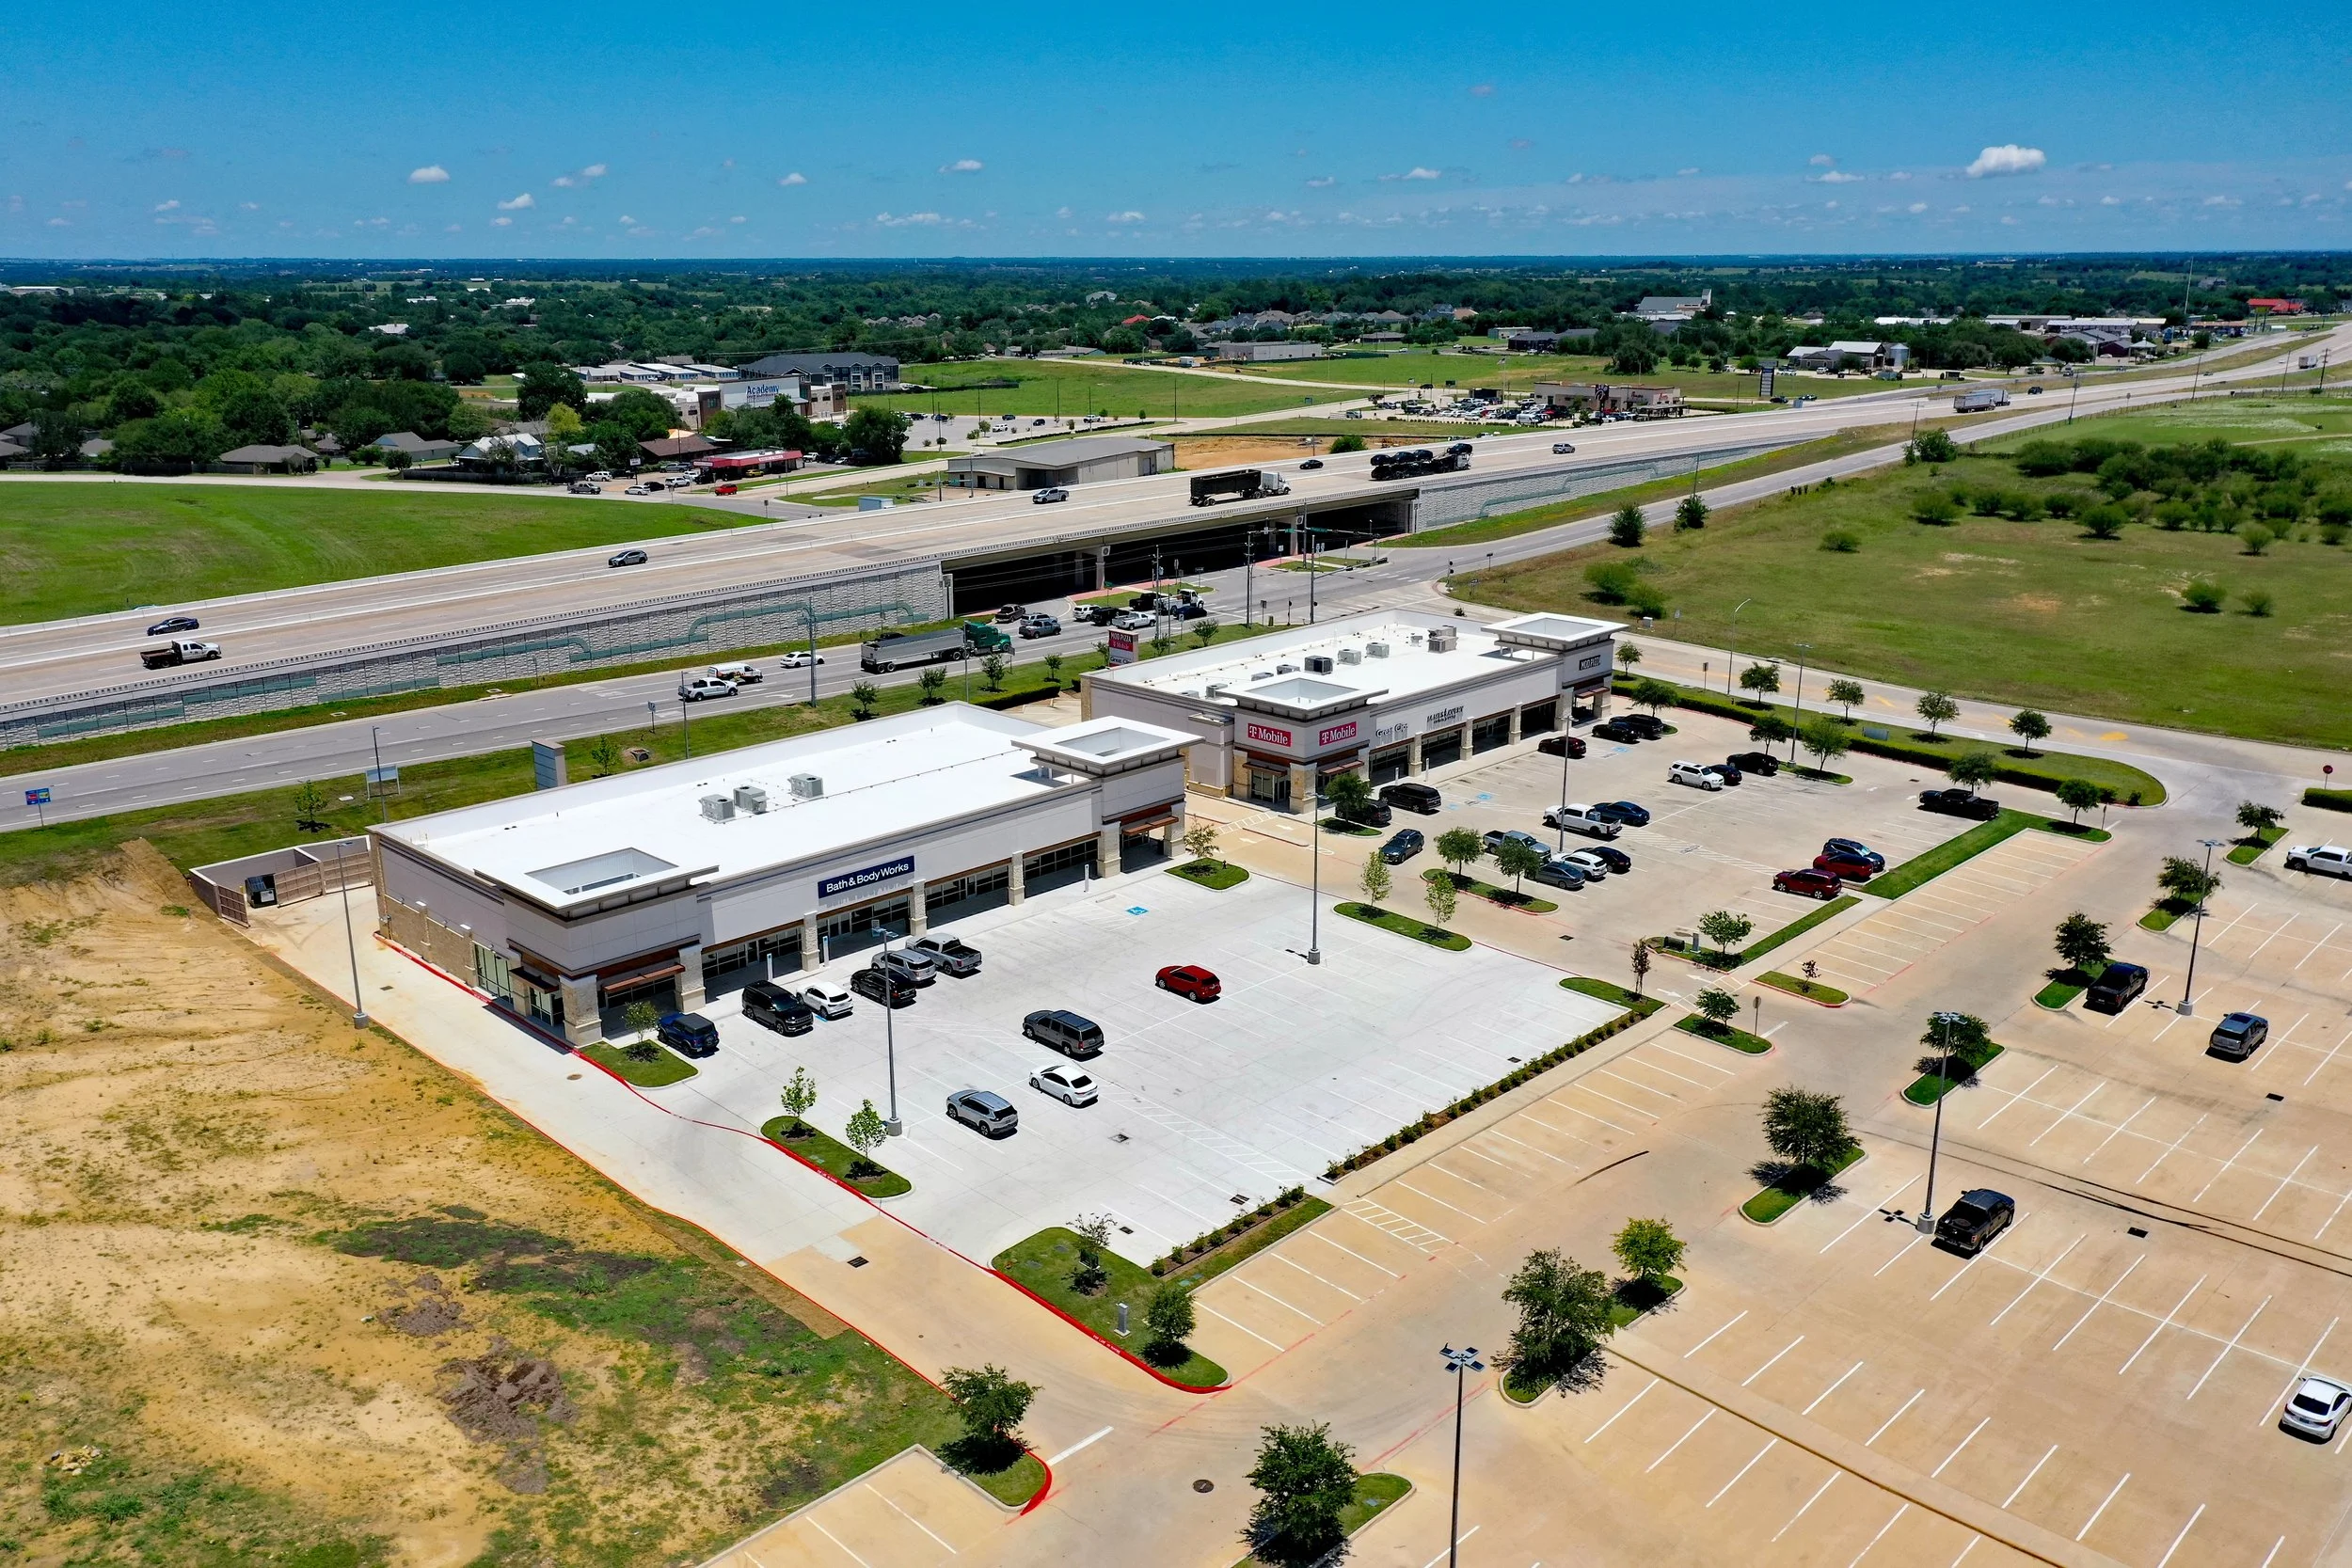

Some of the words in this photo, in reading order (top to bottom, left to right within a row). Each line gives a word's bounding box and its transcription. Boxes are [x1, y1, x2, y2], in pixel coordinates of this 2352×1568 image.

[747, 385, 779, 394] Academy
[1120, 634, 1132, 643] PIZZA
[826, 879, 848, 893] Bath
[849, 877, 856, 887] &
[857, 871, 881, 884] Body
[880, 863, 910, 877] Works
